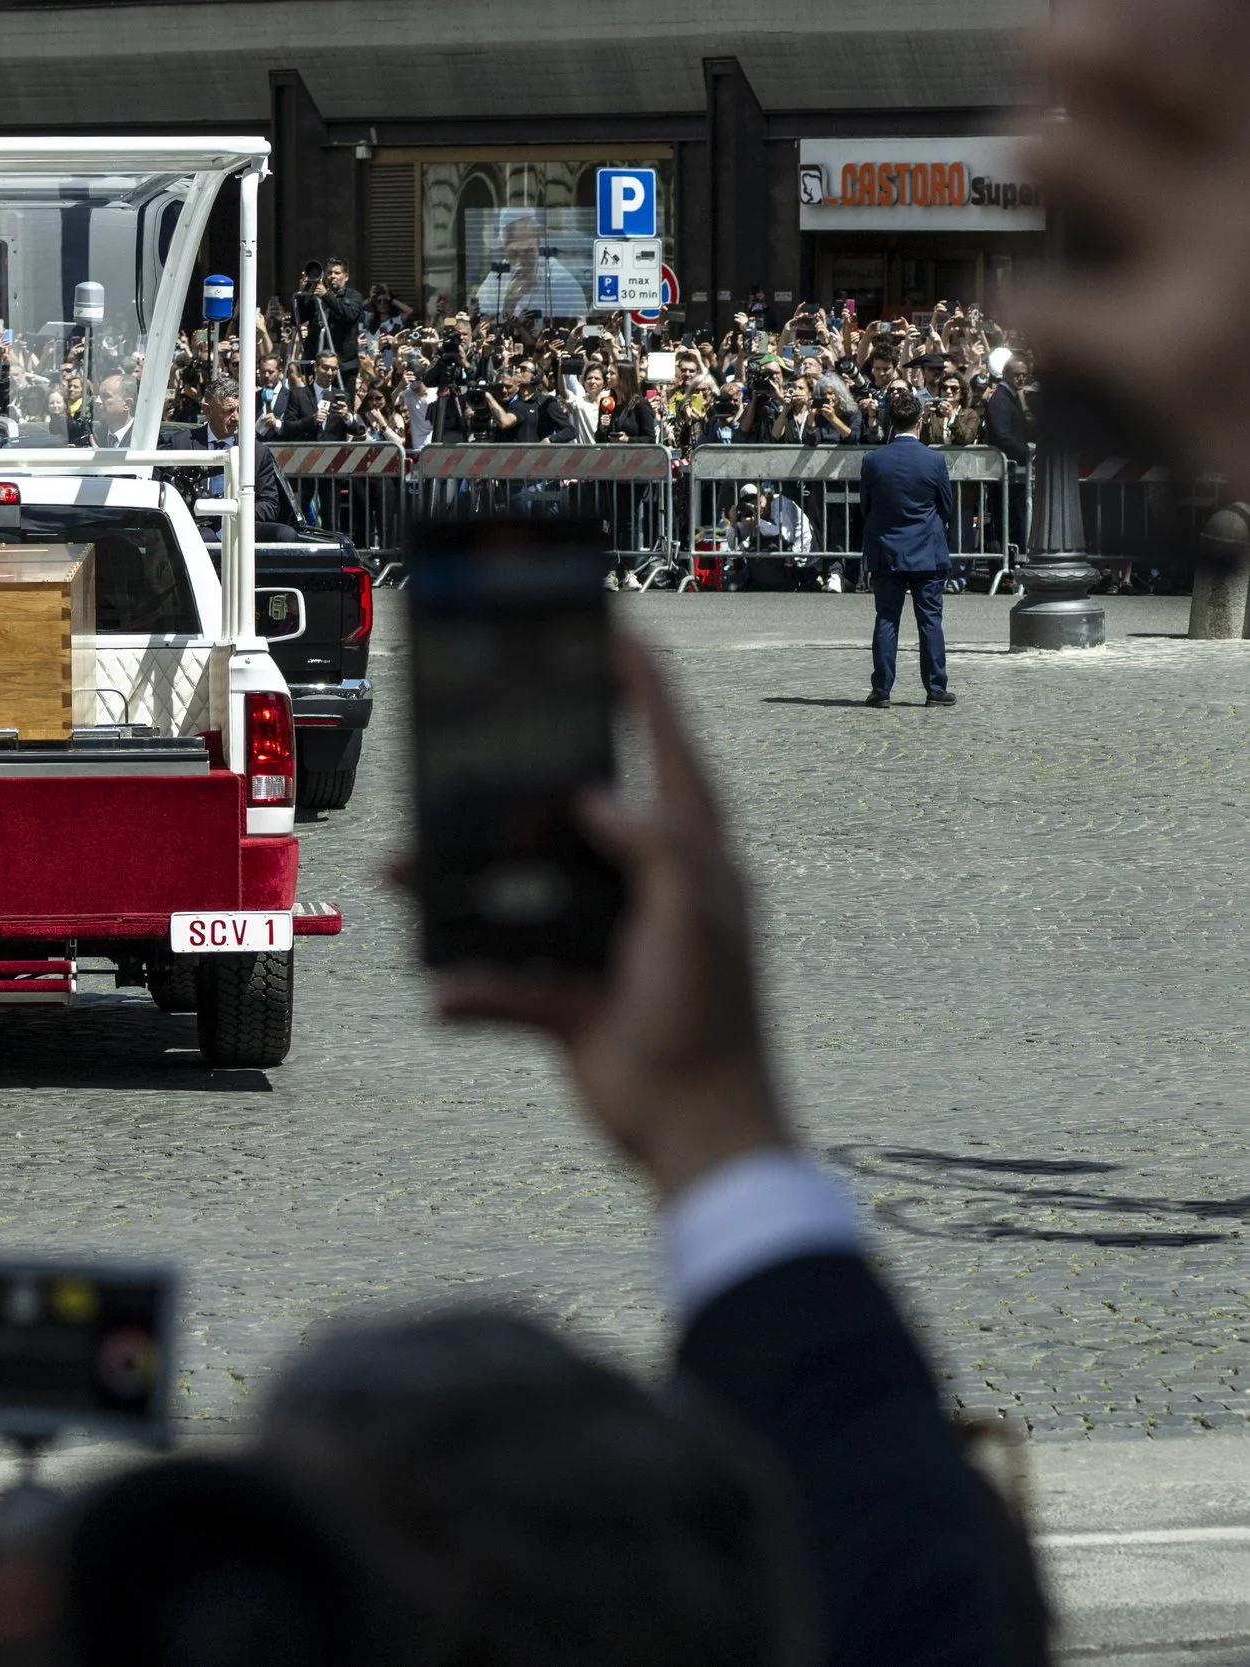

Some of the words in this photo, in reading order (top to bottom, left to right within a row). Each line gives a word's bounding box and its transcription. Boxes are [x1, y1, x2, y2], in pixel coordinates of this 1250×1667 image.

[841, 161, 967, 206] CASTORO
[611, 176, 645, 230] P
[621, 289, 636, 299] 30
[639, 289, 658, 299] min
[628, 277, 650, 285] max
[265, 919, 275, 945] 1
